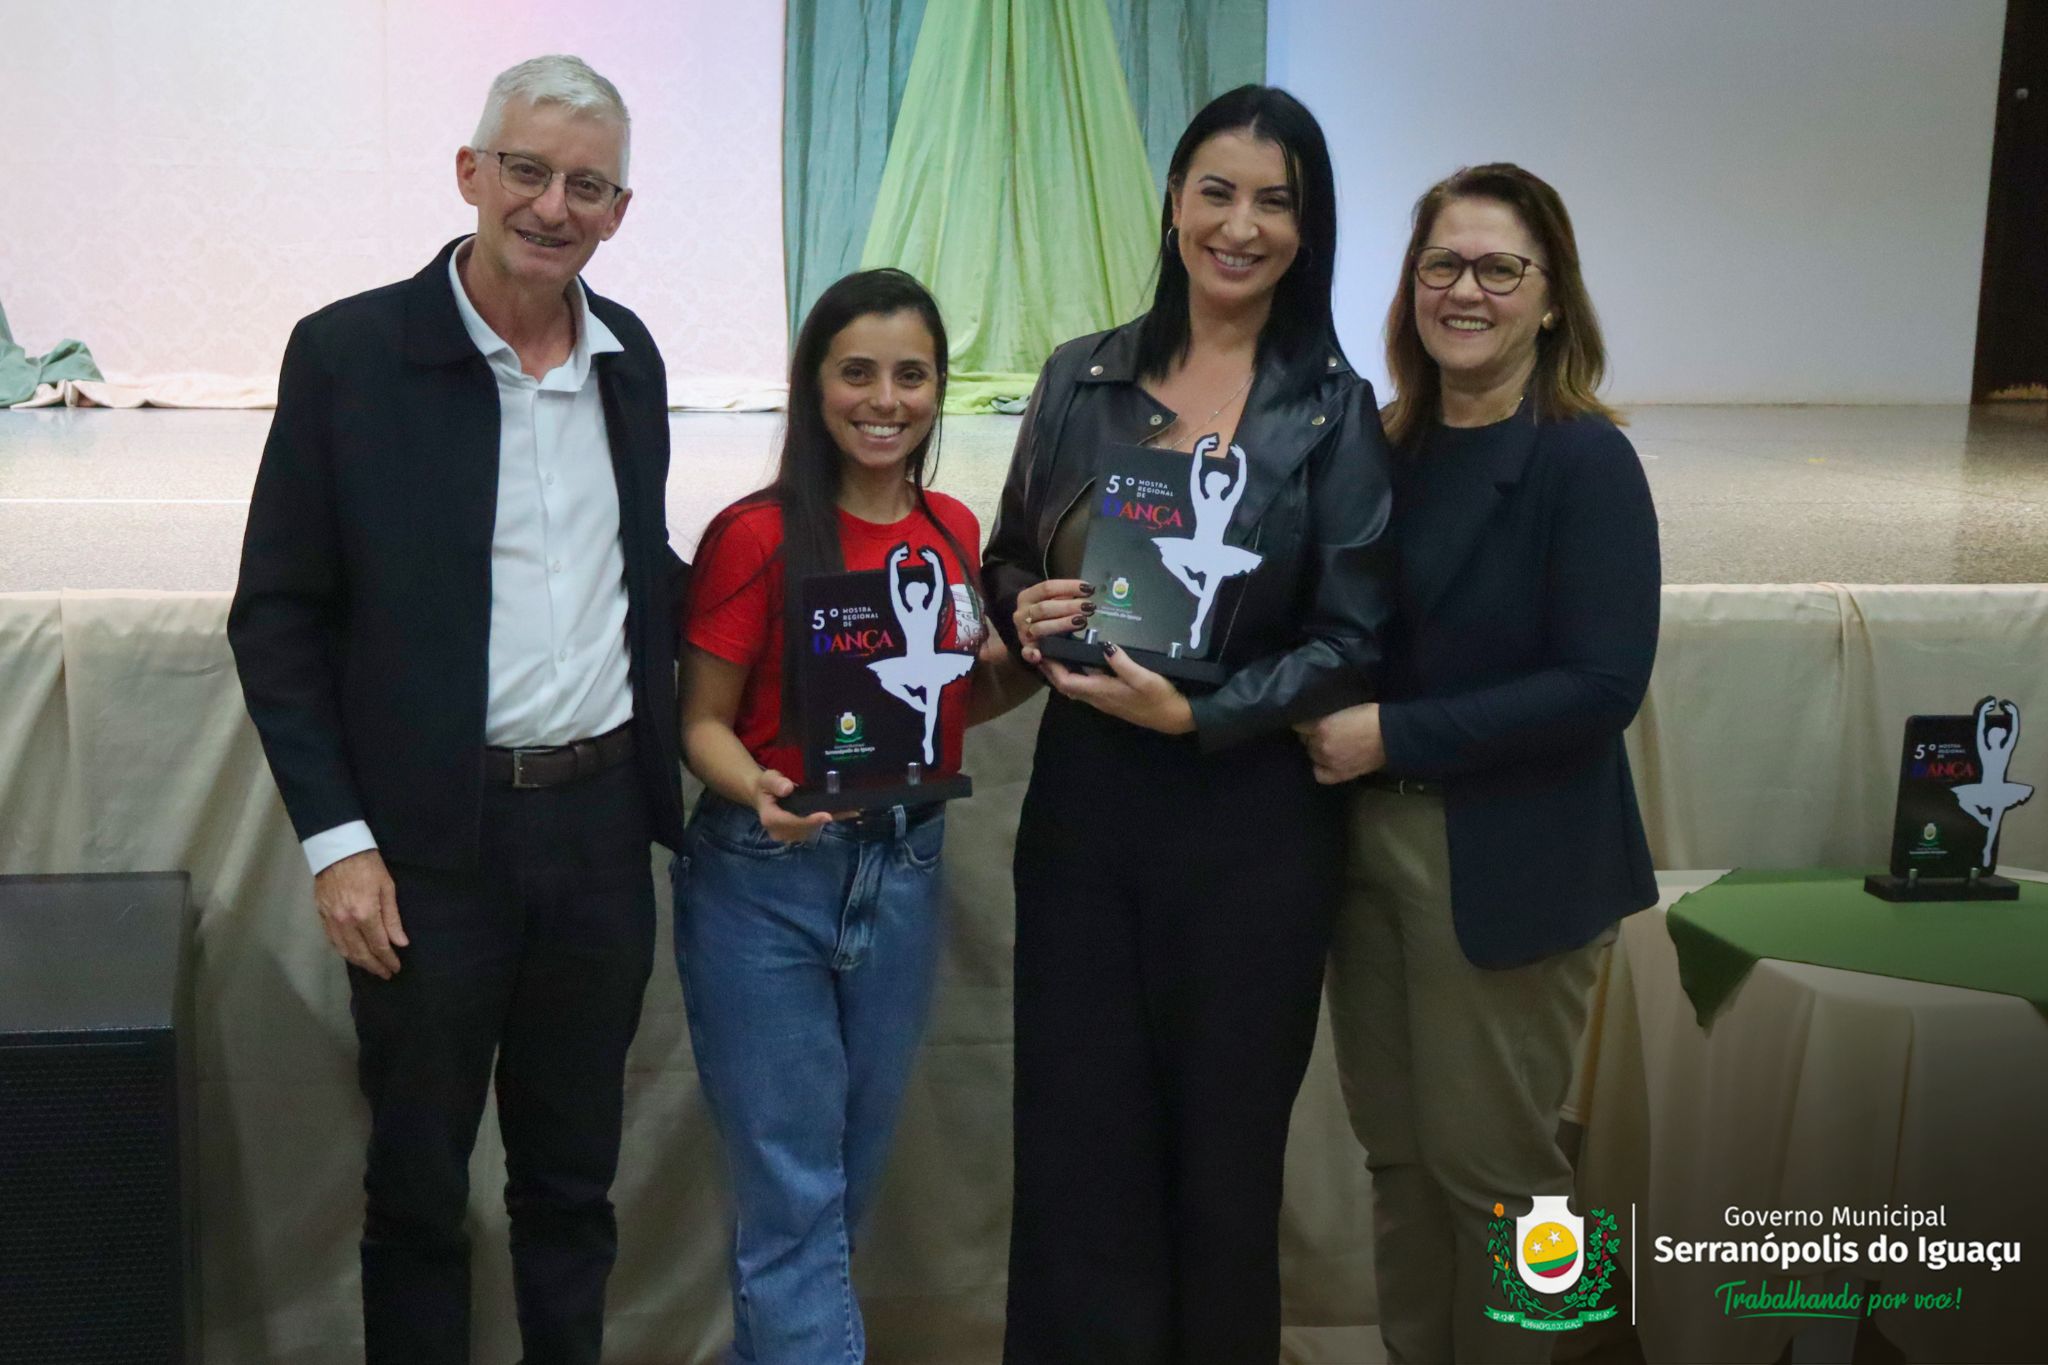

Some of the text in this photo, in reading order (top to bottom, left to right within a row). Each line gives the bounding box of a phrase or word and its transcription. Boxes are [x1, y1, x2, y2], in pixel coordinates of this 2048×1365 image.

[1138, 479, 1168, 489] MOSTRA
[1137, 486, 1174, 497] REGIONAL
[1103, 495, 1183, 529] DANÇA
[842, 606, 872, 614] MOSTRA
[843, 620, 852, 628] DE
[812, 630, 894, 656] DANÇA
